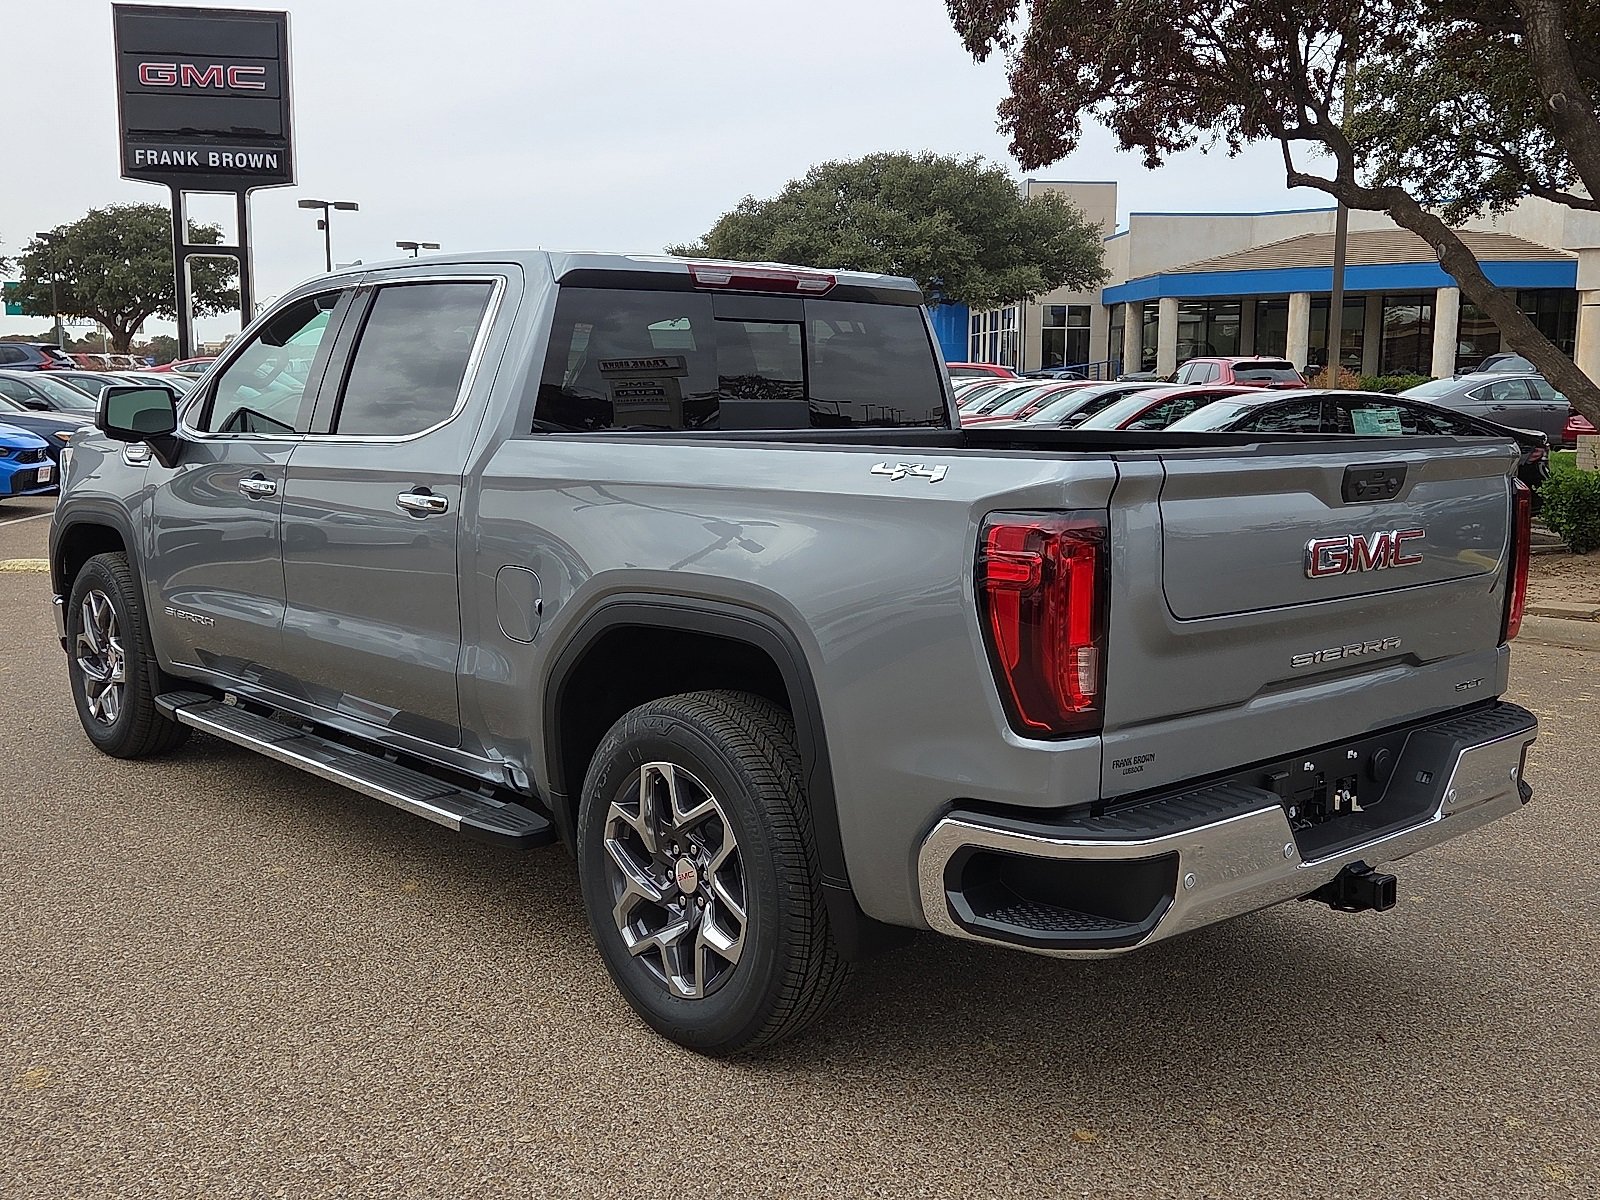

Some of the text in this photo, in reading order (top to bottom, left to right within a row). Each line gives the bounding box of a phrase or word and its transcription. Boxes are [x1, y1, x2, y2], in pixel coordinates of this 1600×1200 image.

[138, 62, 266, 90] GMC
[135, 149, 278, 169] FRANK BROWN
[1304, 529, 1426, 578] GMC
[164, 606, 215, 627] SIERRA
[1290, 636, 1402, 668] SIERRA
[1455, 677, 1485, 692] SLT
[1112, 753, 1155, 769] FRANK BROWN
